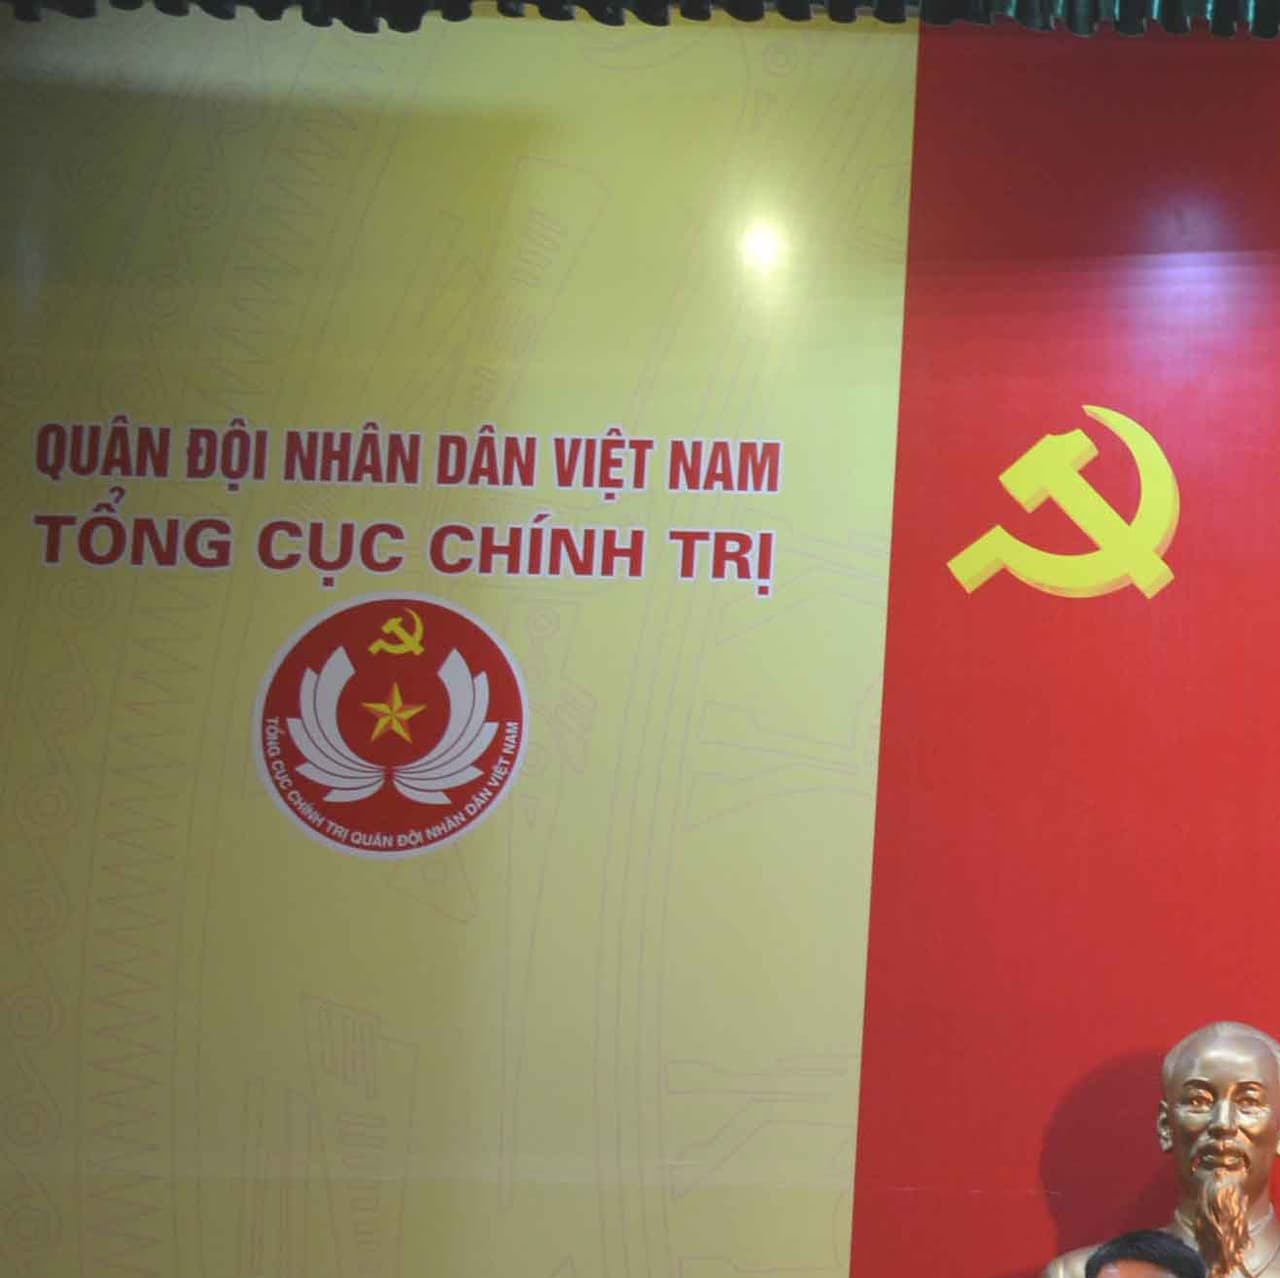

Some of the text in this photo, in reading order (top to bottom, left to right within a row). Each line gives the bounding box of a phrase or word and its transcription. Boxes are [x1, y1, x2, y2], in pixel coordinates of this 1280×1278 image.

[36, 420, 780, 500] QUÂN ĐỘI NHÂN DÂN VIỆT NAM
[34, 486, 773, 596] TỔNG CỤC CHÍNH TRỊ
[501, 721, 519, 755] NAM
